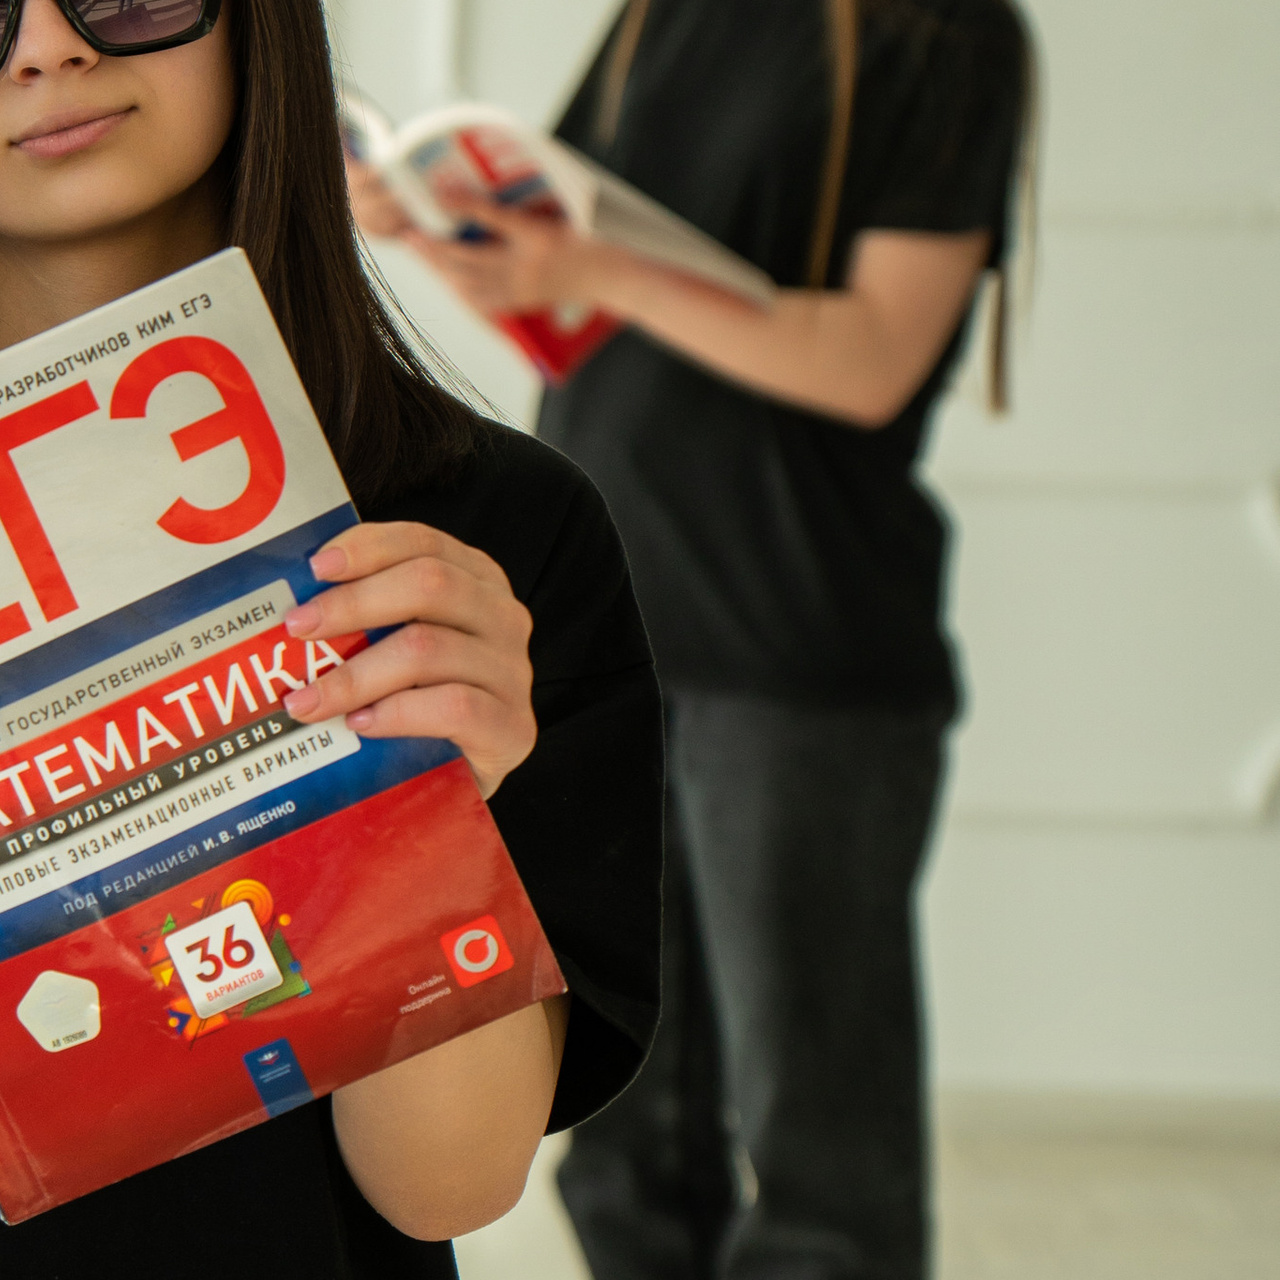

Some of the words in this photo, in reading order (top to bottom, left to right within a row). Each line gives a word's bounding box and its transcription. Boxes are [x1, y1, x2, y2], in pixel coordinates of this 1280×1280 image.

[136, 310, 175, 340] КИМ
[180, 292, 213, 319] ЕГЭ
[6, 641, 185, 736] ГОСУДАРСТВЕННЫЙ
[190, 601, 276, 650] ЭКЗАМЕН
[6, 772, 163, 856] ПРОФИЛЬНЫЙ
[173, 720, 283, 779] УРОВЕНЬ
[67, 775, 236, 864] ЭКЗАМЕНАЦИОННЫЕ
[242, 730, 334, 782] ВАРИАНТЫ
[63, 891, 99, 915] ПОД
[102, 843, 200, 898] РЕДАКЦИЕЙ
[236, 800, 297, 836] ЯЩЕНКО
[184, 923, 255, 983] 36
[205, 968, 265, 1002] ВАРИАНТОВ
[407, 971, 446, 996] Онлайн
